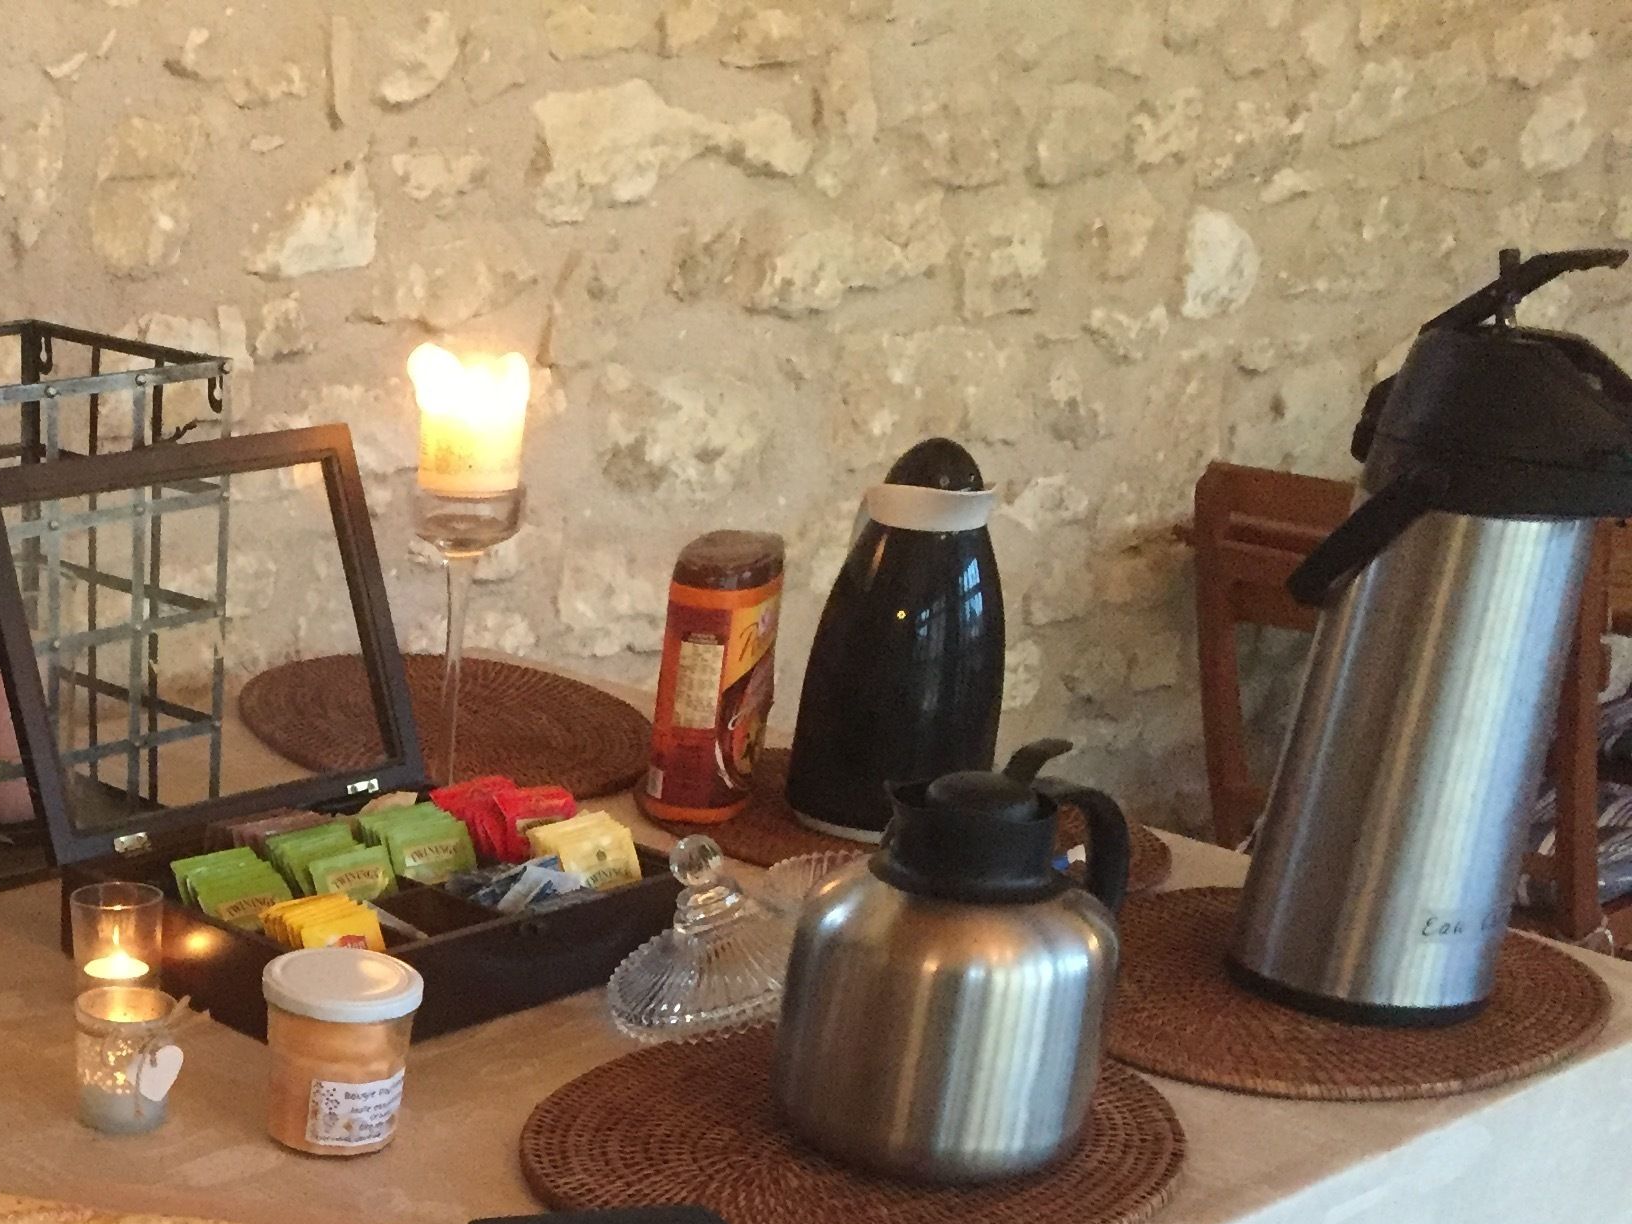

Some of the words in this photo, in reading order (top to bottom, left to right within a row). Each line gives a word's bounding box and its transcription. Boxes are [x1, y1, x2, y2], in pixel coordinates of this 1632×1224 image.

[410, 846, 460, 865] TWININGS
[333, 867, 384, 889] TWININGS
[226, 897, 276, 917] TWININGS
